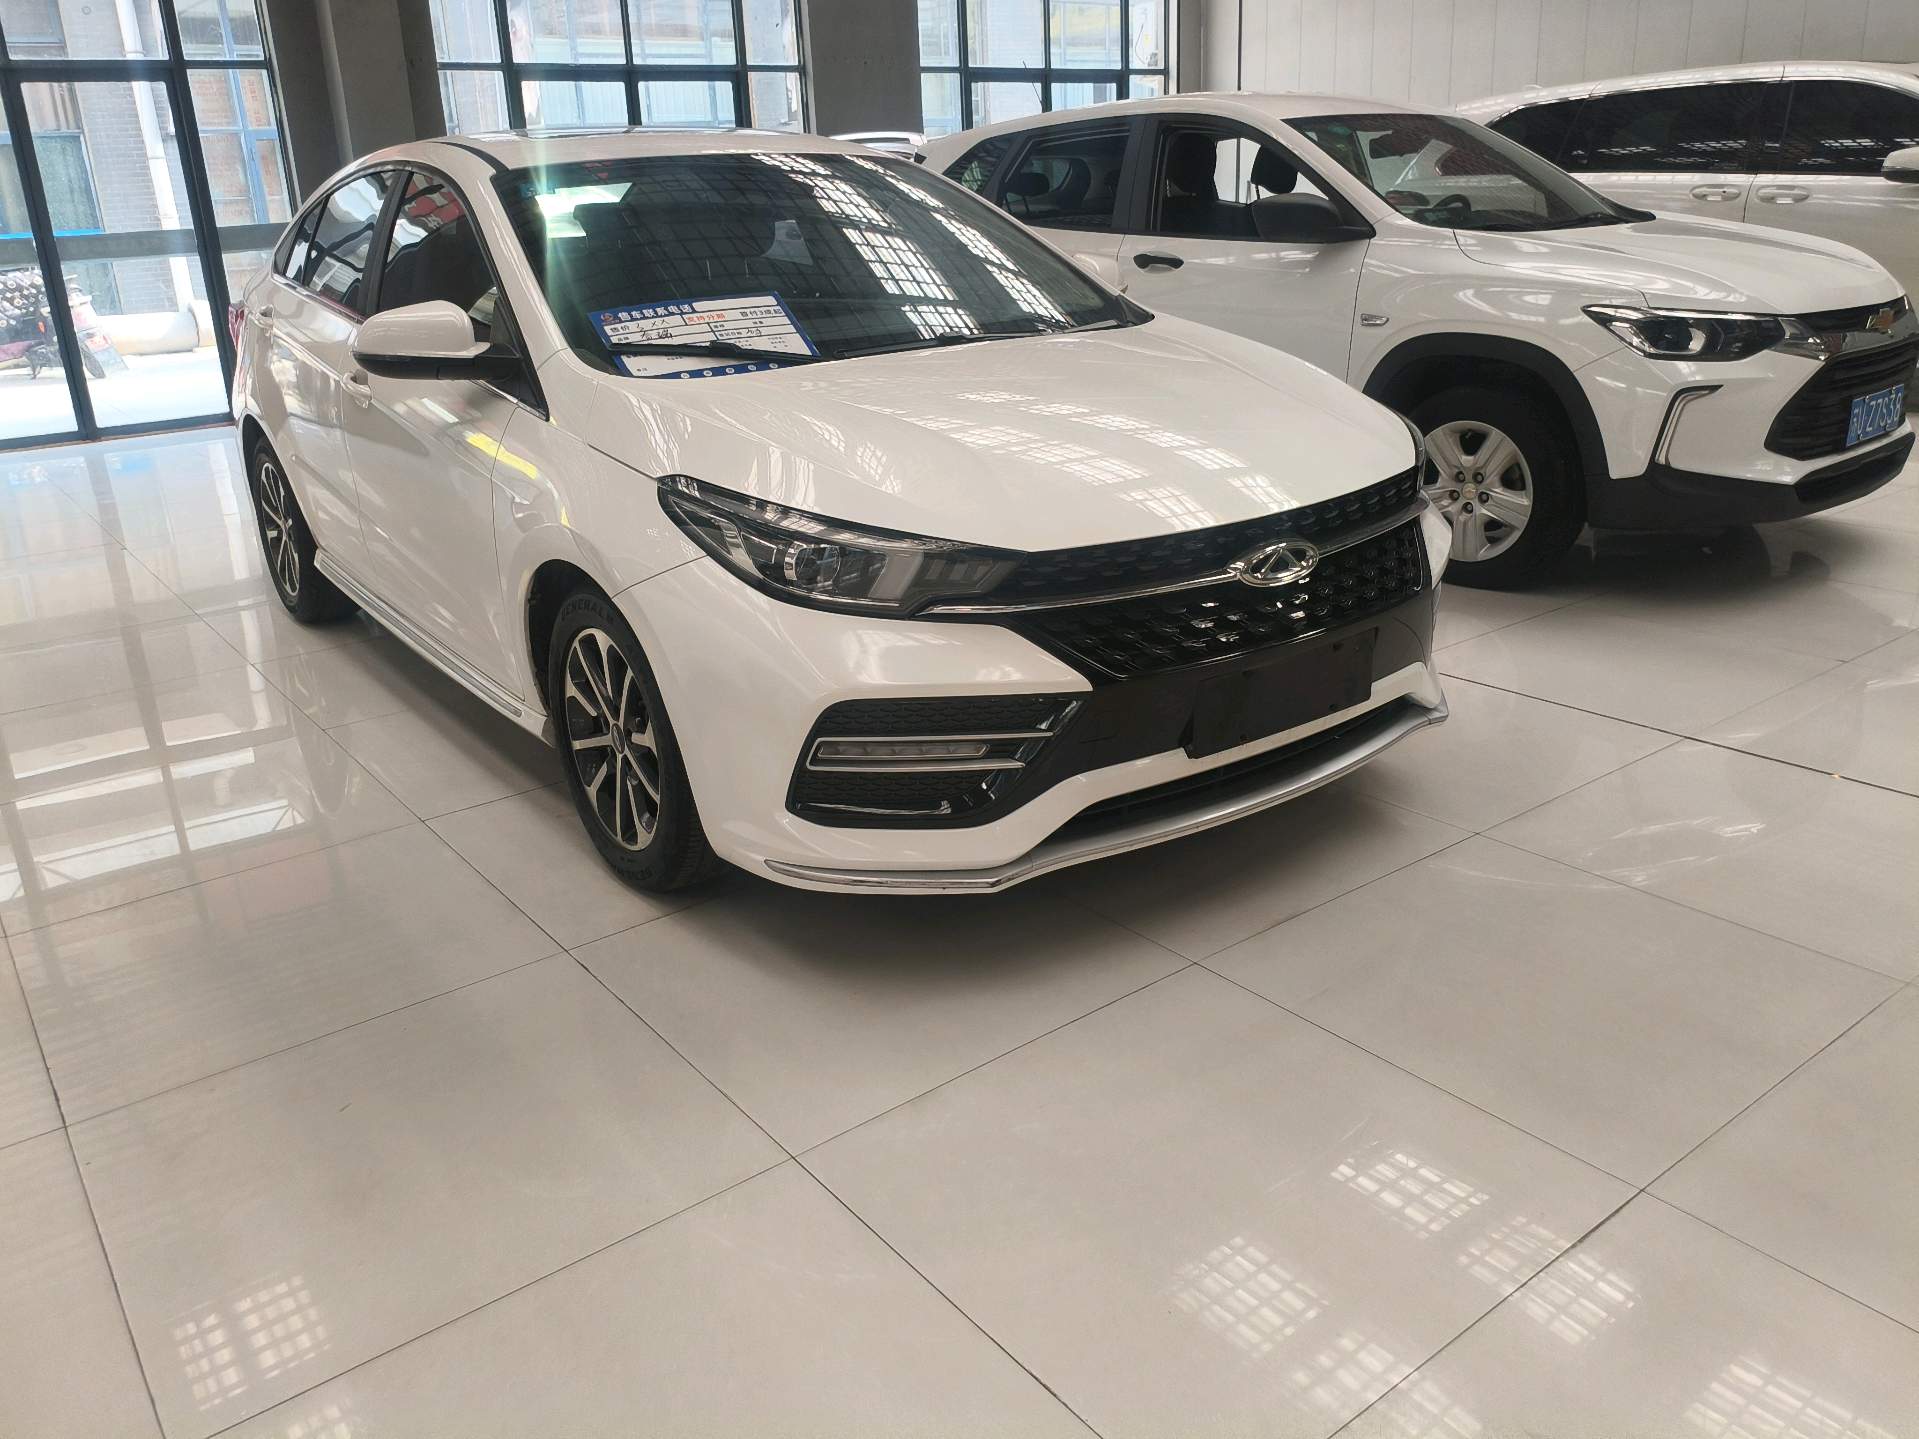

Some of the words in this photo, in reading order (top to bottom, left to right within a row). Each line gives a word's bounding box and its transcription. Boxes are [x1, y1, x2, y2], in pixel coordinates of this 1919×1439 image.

[617, 304, 692, 321] 售车联系电话
